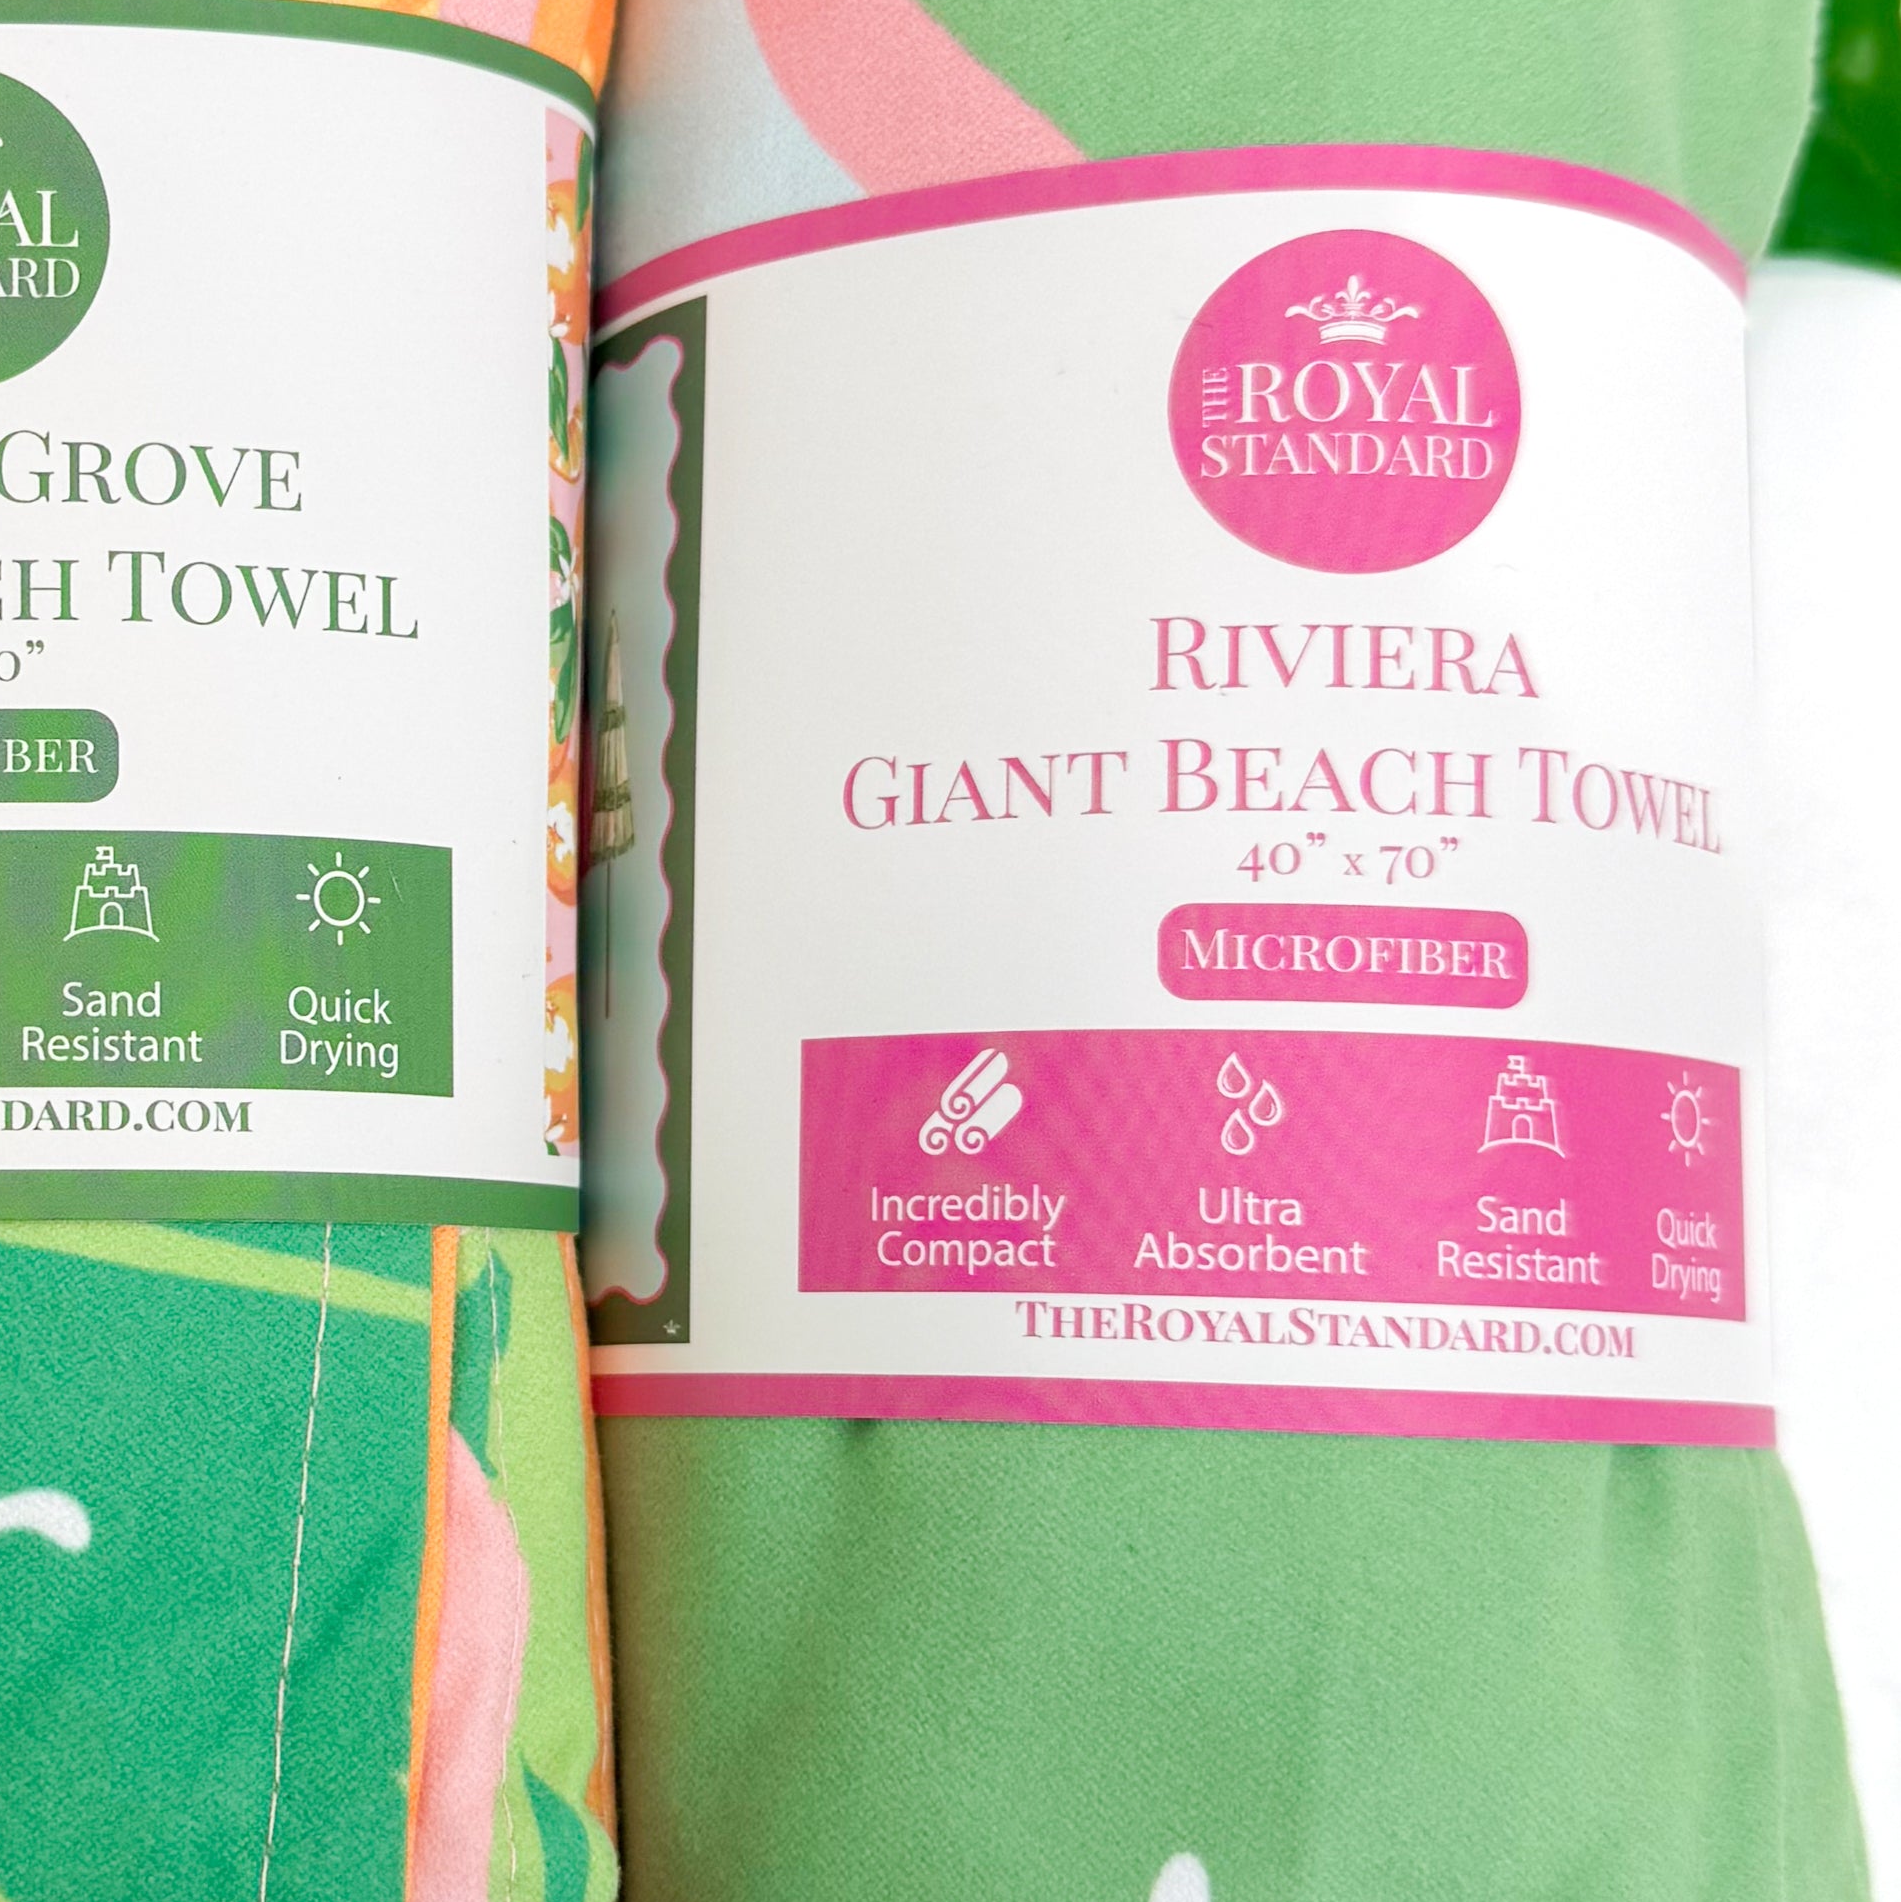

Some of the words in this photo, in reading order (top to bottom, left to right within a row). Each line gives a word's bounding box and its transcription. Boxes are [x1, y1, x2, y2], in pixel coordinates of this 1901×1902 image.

[1202, 367, 1229, 427] THE
[1234, 361, 1495, 428] ROYAL
[1199, 433, 1495, 482] STANDARD
[107, 549, 420, 641] TOWEL
[1148, 616, 1540, 699] RIVIERA
[842, 748, 1127, 831] GIANT
[1158, 739, 1494, 821] BEACH
[1518, 745, 1723, 856] TOWEL
[1179, 928, 1513, 980] MICROFIBER
[61, 980, 162, 1018] Sand
[287, 988, 393, 1027] Quick
[21, 1024, 203, 1064] Resistant
[279, 1030, 401, 1077] Drying
[870, 1185, 1065, 1231] Incredibly
[1197, 1188, 1303, 1227] Ultra
[1475, 1197, 1568, 1238] Sand
[875, 1230, 1056, 1275] Compact
[1655, 1208, 1718, 1253] Quick
[1133, 1233, 1367, 1276] Absorbent
[1436, 1241, 1601, 1286] Resistant
[1650, 1254, 1722, 1304] Drying
